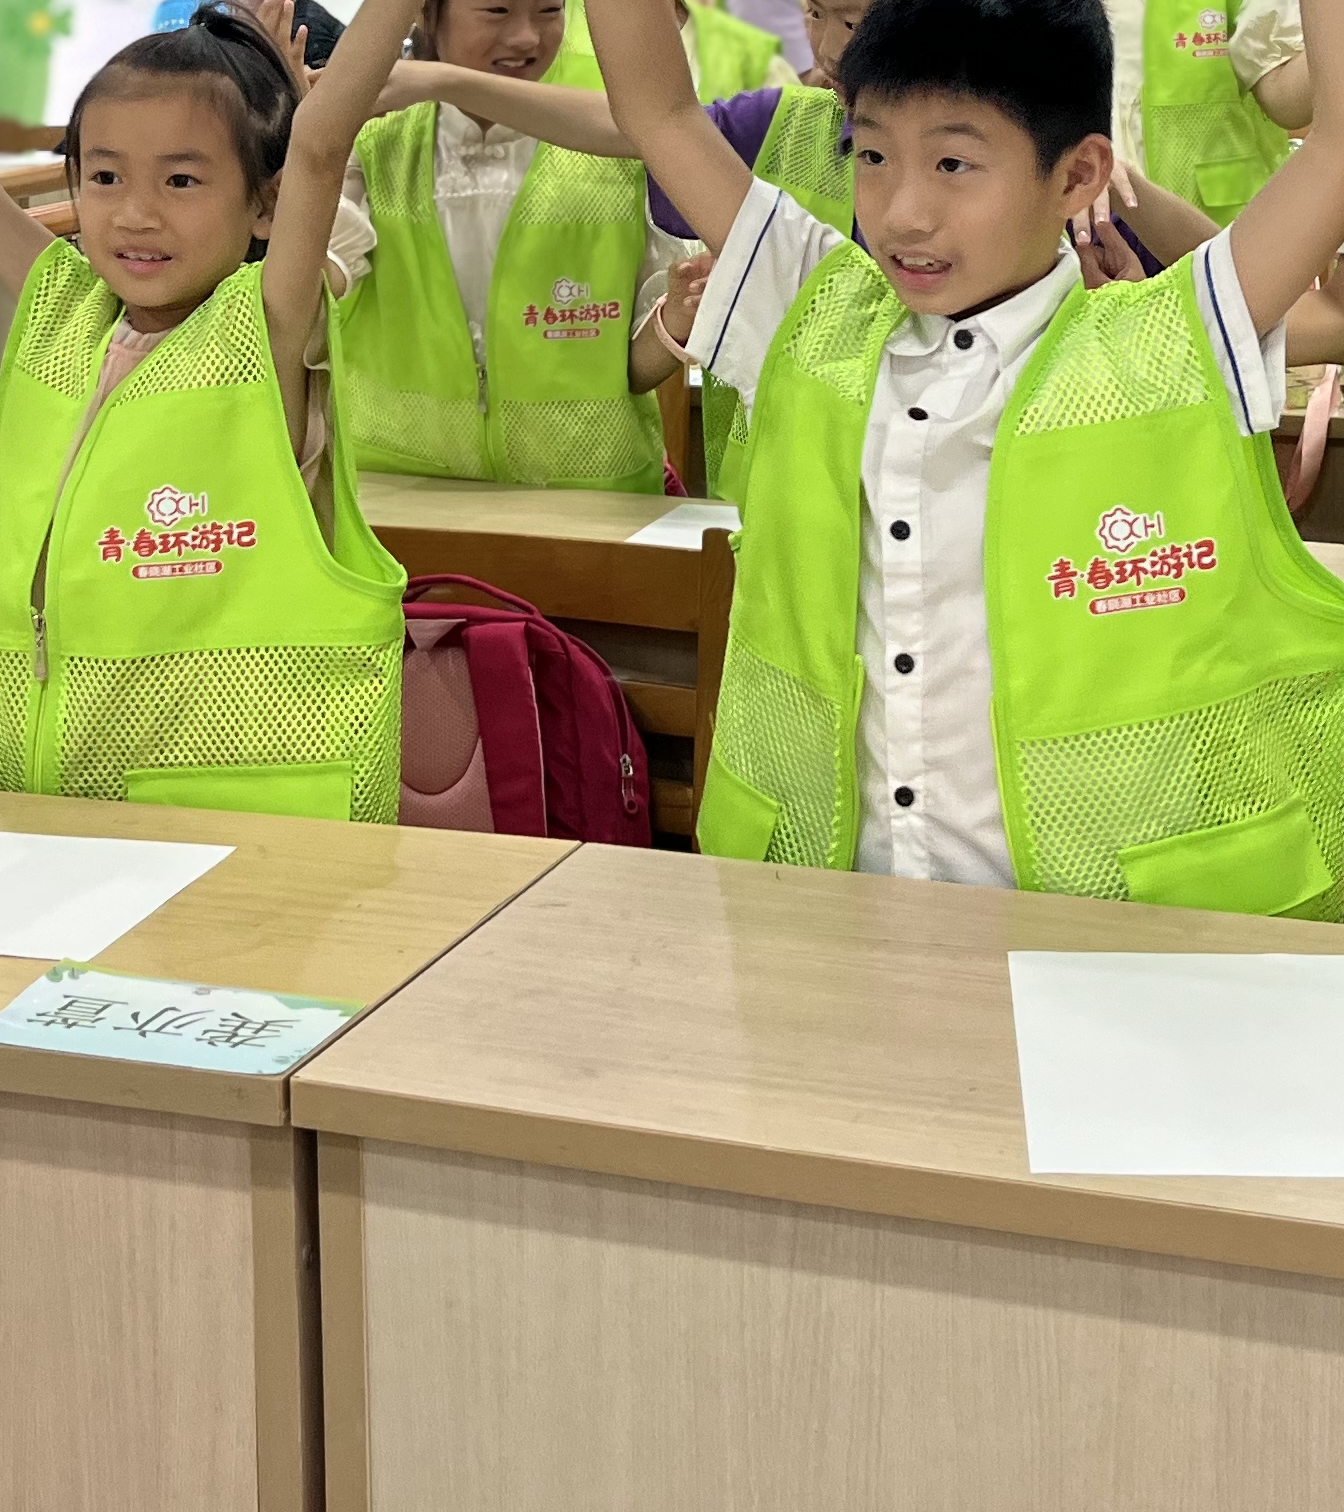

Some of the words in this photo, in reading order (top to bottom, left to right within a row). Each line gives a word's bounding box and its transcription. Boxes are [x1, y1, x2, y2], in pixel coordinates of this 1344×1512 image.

[98, 521, 257, 563] 青春环游记
[1047, 539, 1217, 598] 青春环游记
[26, 994, 302, 1049] 龚亦萱
